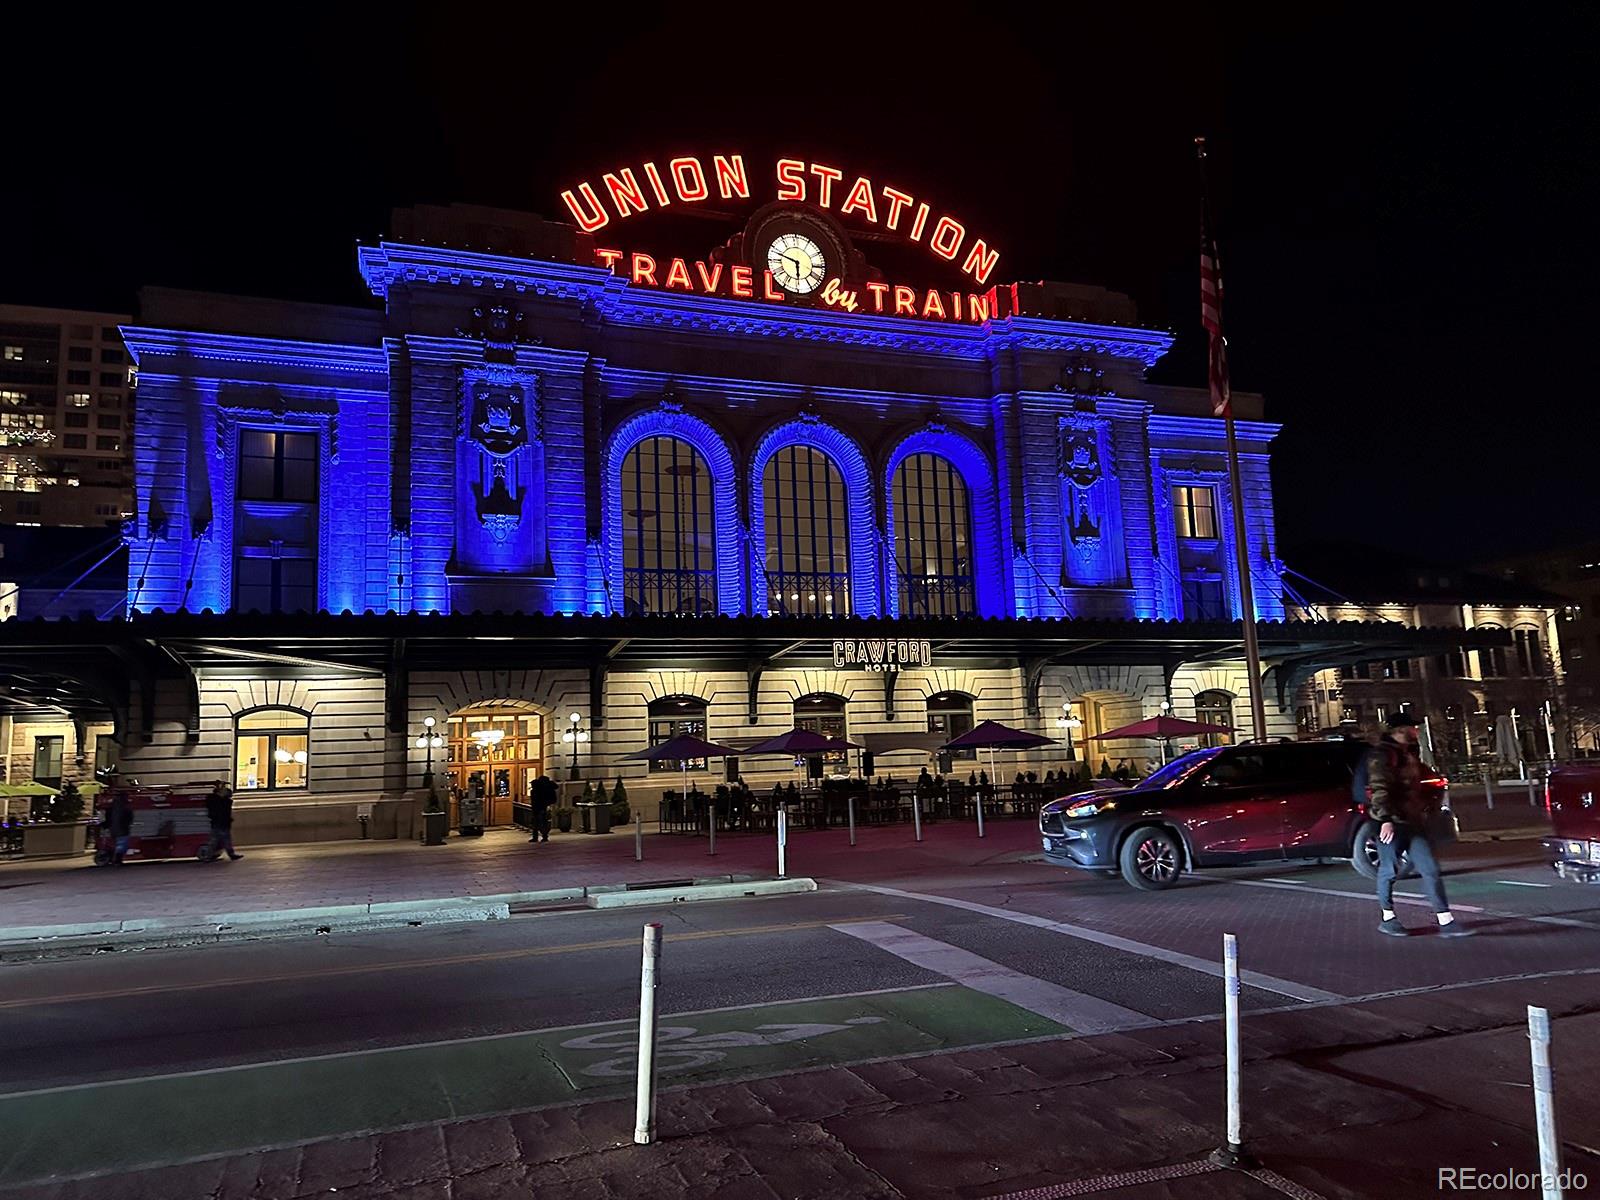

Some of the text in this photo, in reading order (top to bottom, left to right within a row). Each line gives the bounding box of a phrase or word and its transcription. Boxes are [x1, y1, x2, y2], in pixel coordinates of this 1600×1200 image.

[561, 155, 750, 233] UNION
[777, 158, 1000, 285] STATION
[597, 248, 785, 301] TRAVEL
[820, 278, 858, 313] by
[866, 282, 989, 322] TRAIN
[833, 641, 932, 668] CRAWFORD
[864, 664, 904, 672] HOTEL
